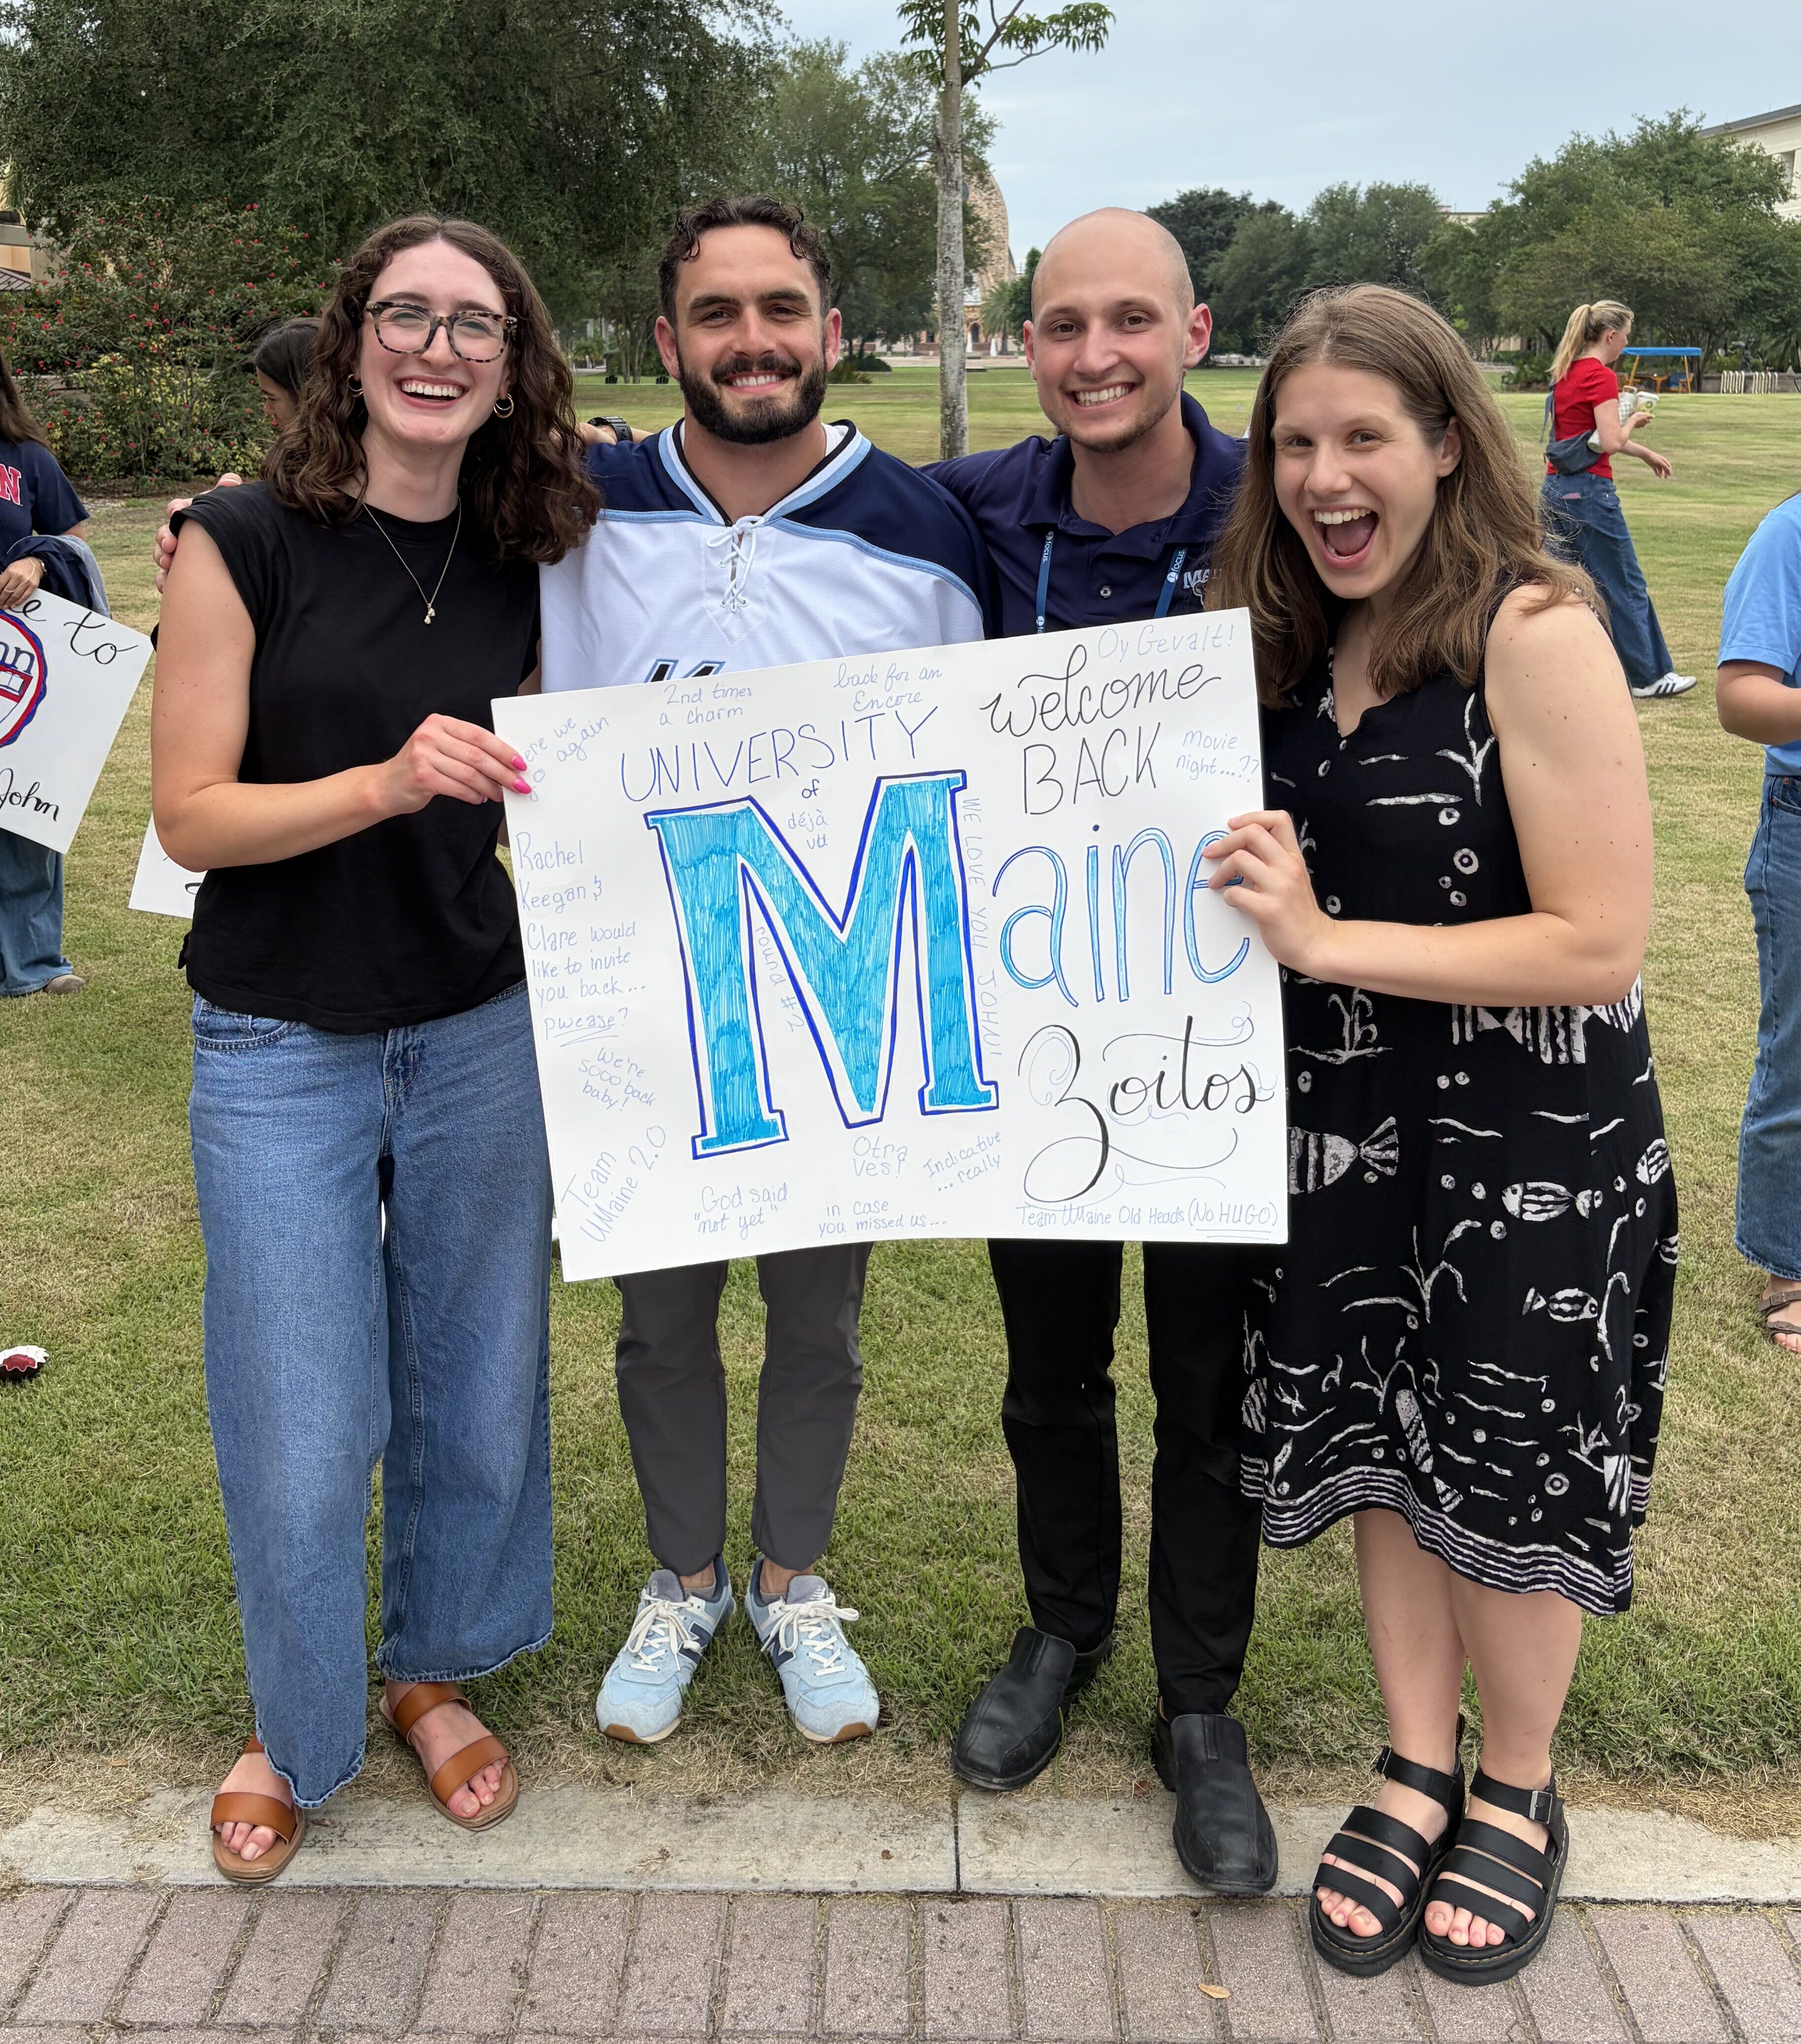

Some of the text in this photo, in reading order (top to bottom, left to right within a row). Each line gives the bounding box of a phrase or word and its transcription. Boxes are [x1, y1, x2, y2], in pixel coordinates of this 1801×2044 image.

[64, 611, 139, 664] to
[1098, 624, 1234, 663] Oy Gevalt!
[833, 662, 943, 692] back for an
[664, 683, 752, 705] 2nd times
[853, 690, 923, 712] Encore
[659, 707, 743, 725] a charm
[525, 718, 576, 762] ere we
[557, 717, 609, 761] again
[621, 706, 938, 802] UNIVERSITY
[1023, 722, 1161, 815] BACK
[801, 778, 820, 798] of
[788, 808, 829, 832] déjà
[962, 797, 981, 823] WE
[515, 831, 583, 870] Rachel
[965, 836, 985, 887] LOVE
[518, 878, 586, 914] Keegan
[527, 922, 636, 951] Clare would
[970, 907, 987, 949] YOU
[532, 947, 630, 978] like to invite
[755, 926, 786, 987] round
[535, 986, 569, 1007] you
[597, 1047, 645, 1078] We're
[582, 1079, 629, 1111] baby!
[624, 1080, 656, 1107] back
[853, 1136, 907, 1161] Otra
[923, 1131, 1001, 1177] Indicative
[560, 1152, 617, 1208] Team
[579, 1125, 666, 1242] UMaine 2.0
[701, 1182, 787, 1212] God said
[826, 1200, 889, 1217] in case
[819, 1221, 846, 1237] you
[856, 1214, 904, 1231] missed
[1015, 1205, 1056, 1227] Team
[1062, 1202, 1112, 1226] UMaine
[1118, 1205, 1141, 1225] Old
[1148, 1205, 1184, 1225] Heads
[1219, 1201, 1278, 1227] HUGO)
